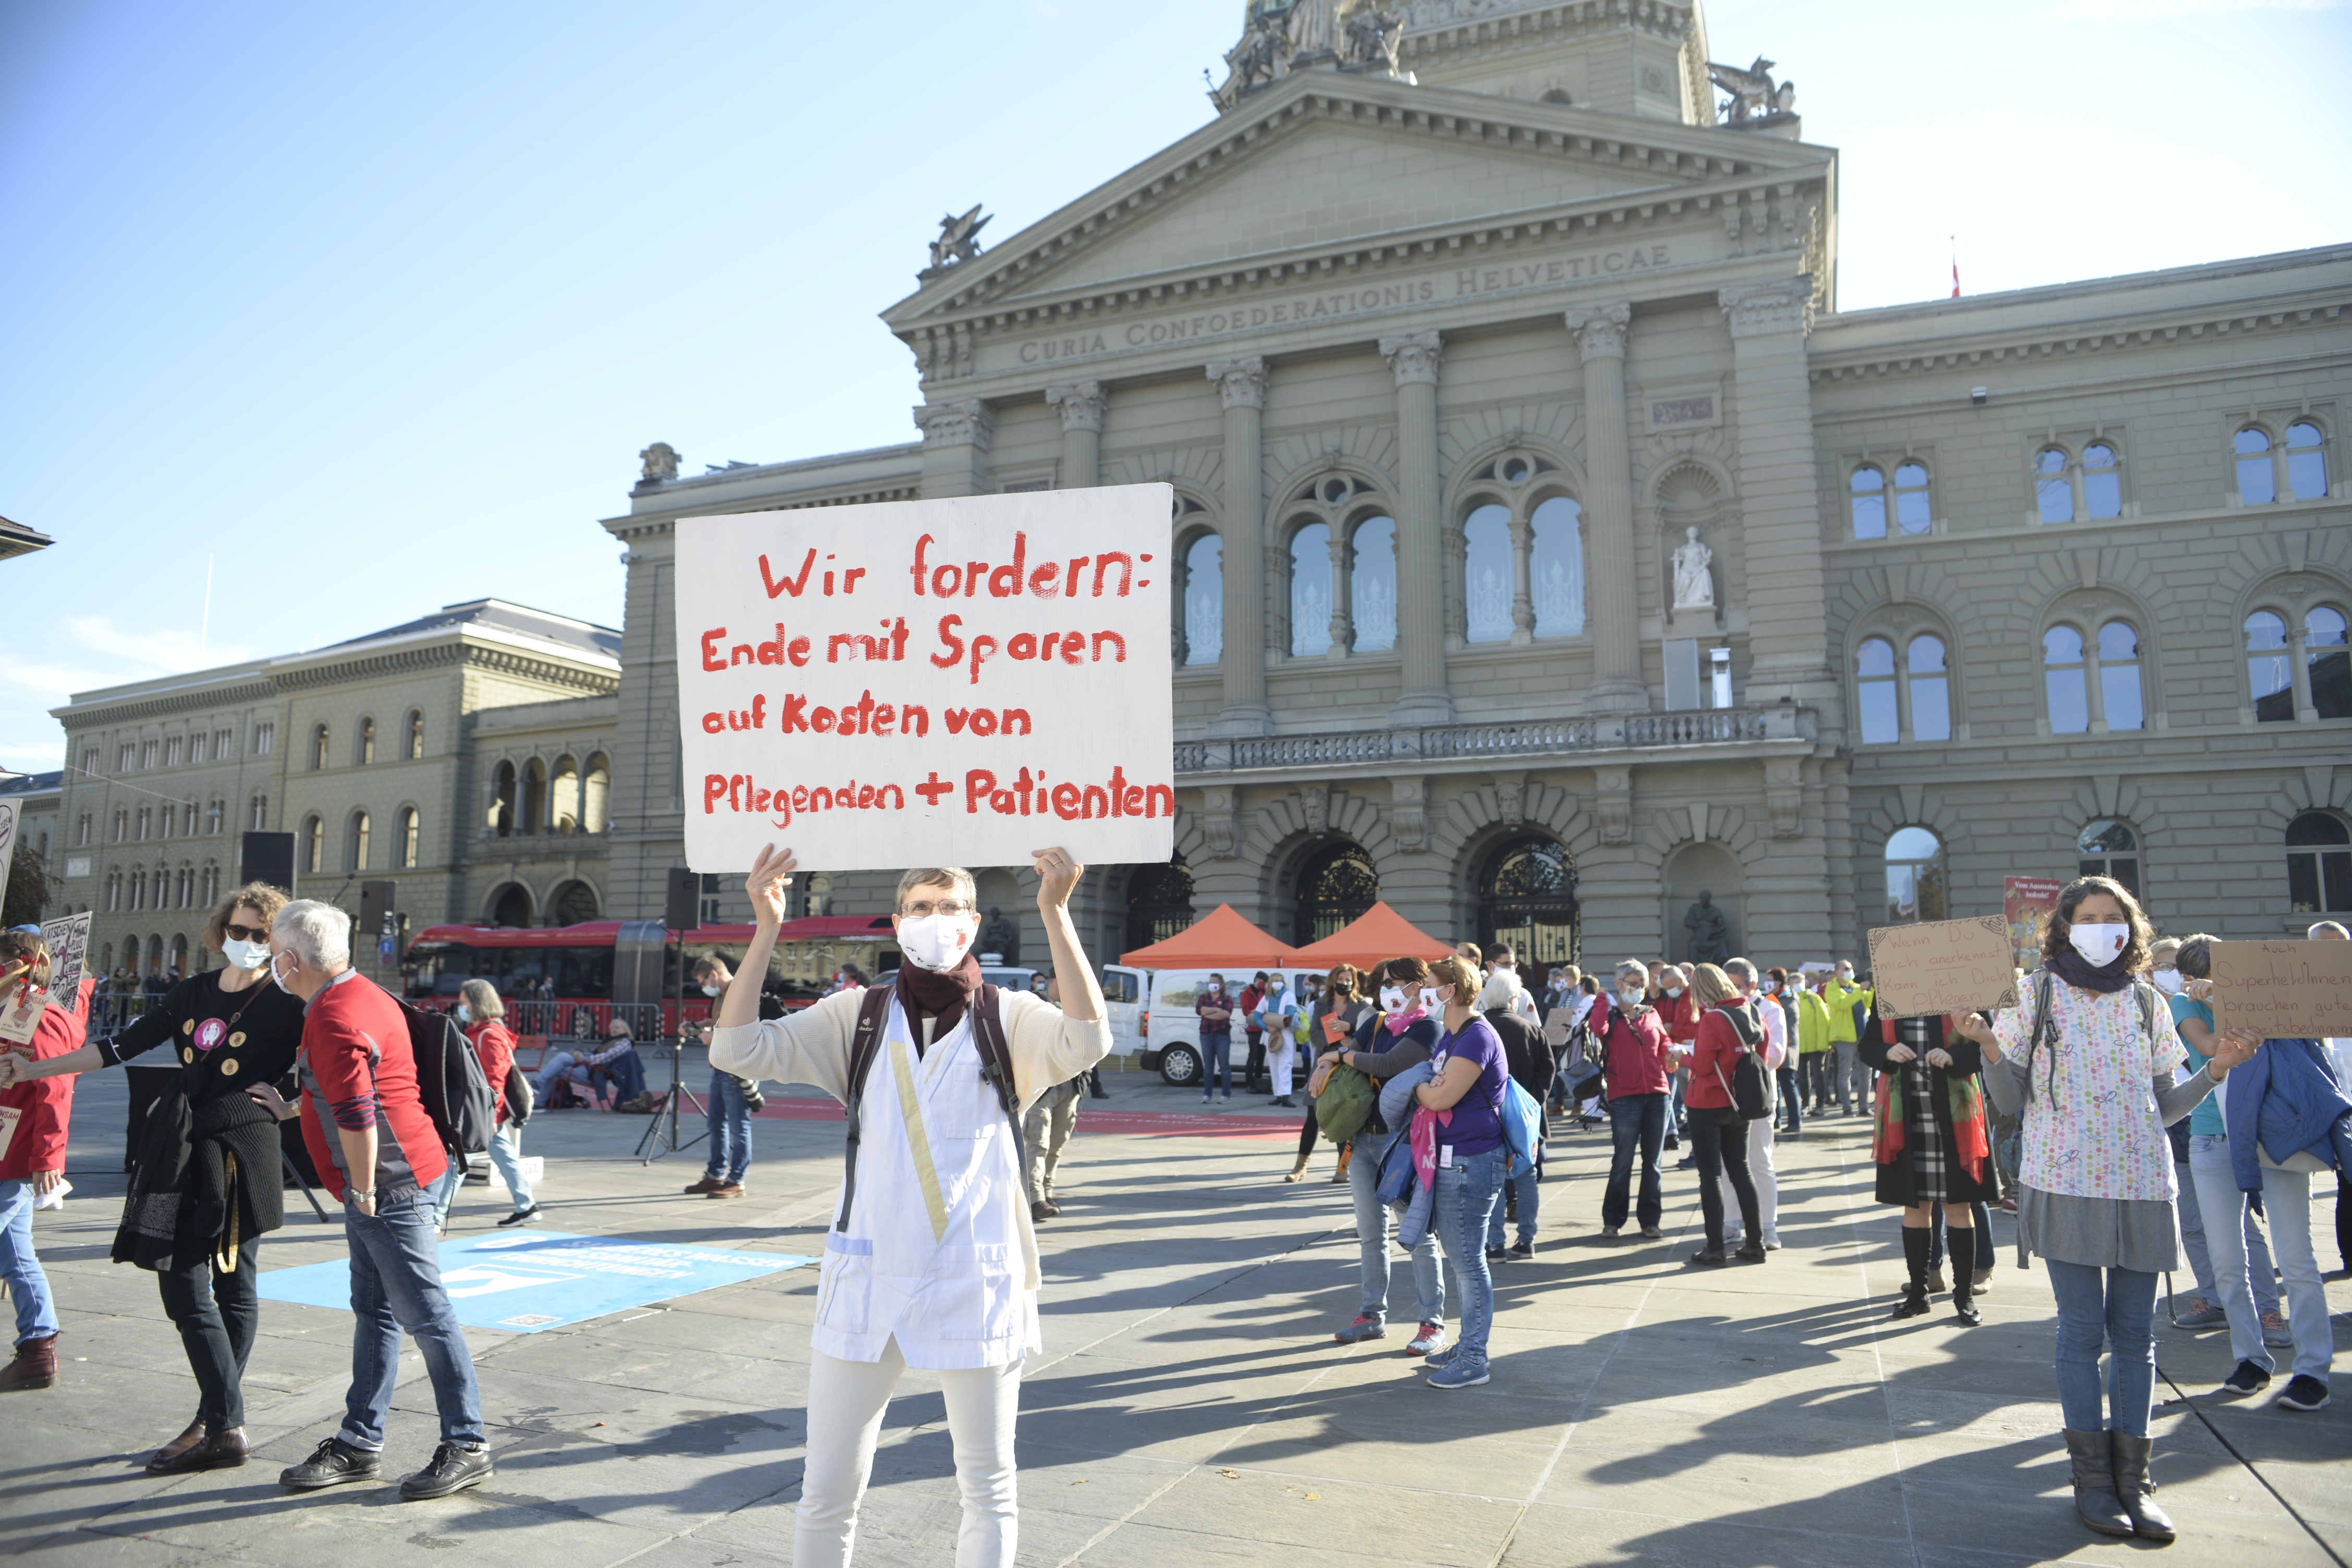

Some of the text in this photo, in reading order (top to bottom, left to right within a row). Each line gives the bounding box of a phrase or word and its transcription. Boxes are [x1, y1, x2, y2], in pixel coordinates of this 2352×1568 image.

[1020, 244, 1671, 363] CURIA CONFOEDERATIONIS HELVETICAE
[758, 531, 1153, 599] Wir fordern:
[701, 613, 1126, 684] Ende mit Sparen
[702, 689, 1032, 737] auf Kosten von
[704, 766, 1173, 830] Pflegenden + Patienten
[1888, 925, 1974, 949] Wenn Du
[2262, 943, 2296, 952] Auch
[1880, 942, 2003, 970] mich anerkennst
[1934, 972, 1958, 986] ich
[1971, 967, 2008, 984] Dich
[2214, 961, 2351, 992] SuperheldInnen
[2222, 993, 2351, 1016] brauchen gute
[2048, 1023, 2057, 1040] deuter
[474, 1235, 548, 1248] 6
[562, 1241, 796, 1268] SAUBERES WASSER
[489, 1253, 695, 1279] EINRICHTUNGEN
[528, 1246, 693, 1268] UND SANITÄR-
